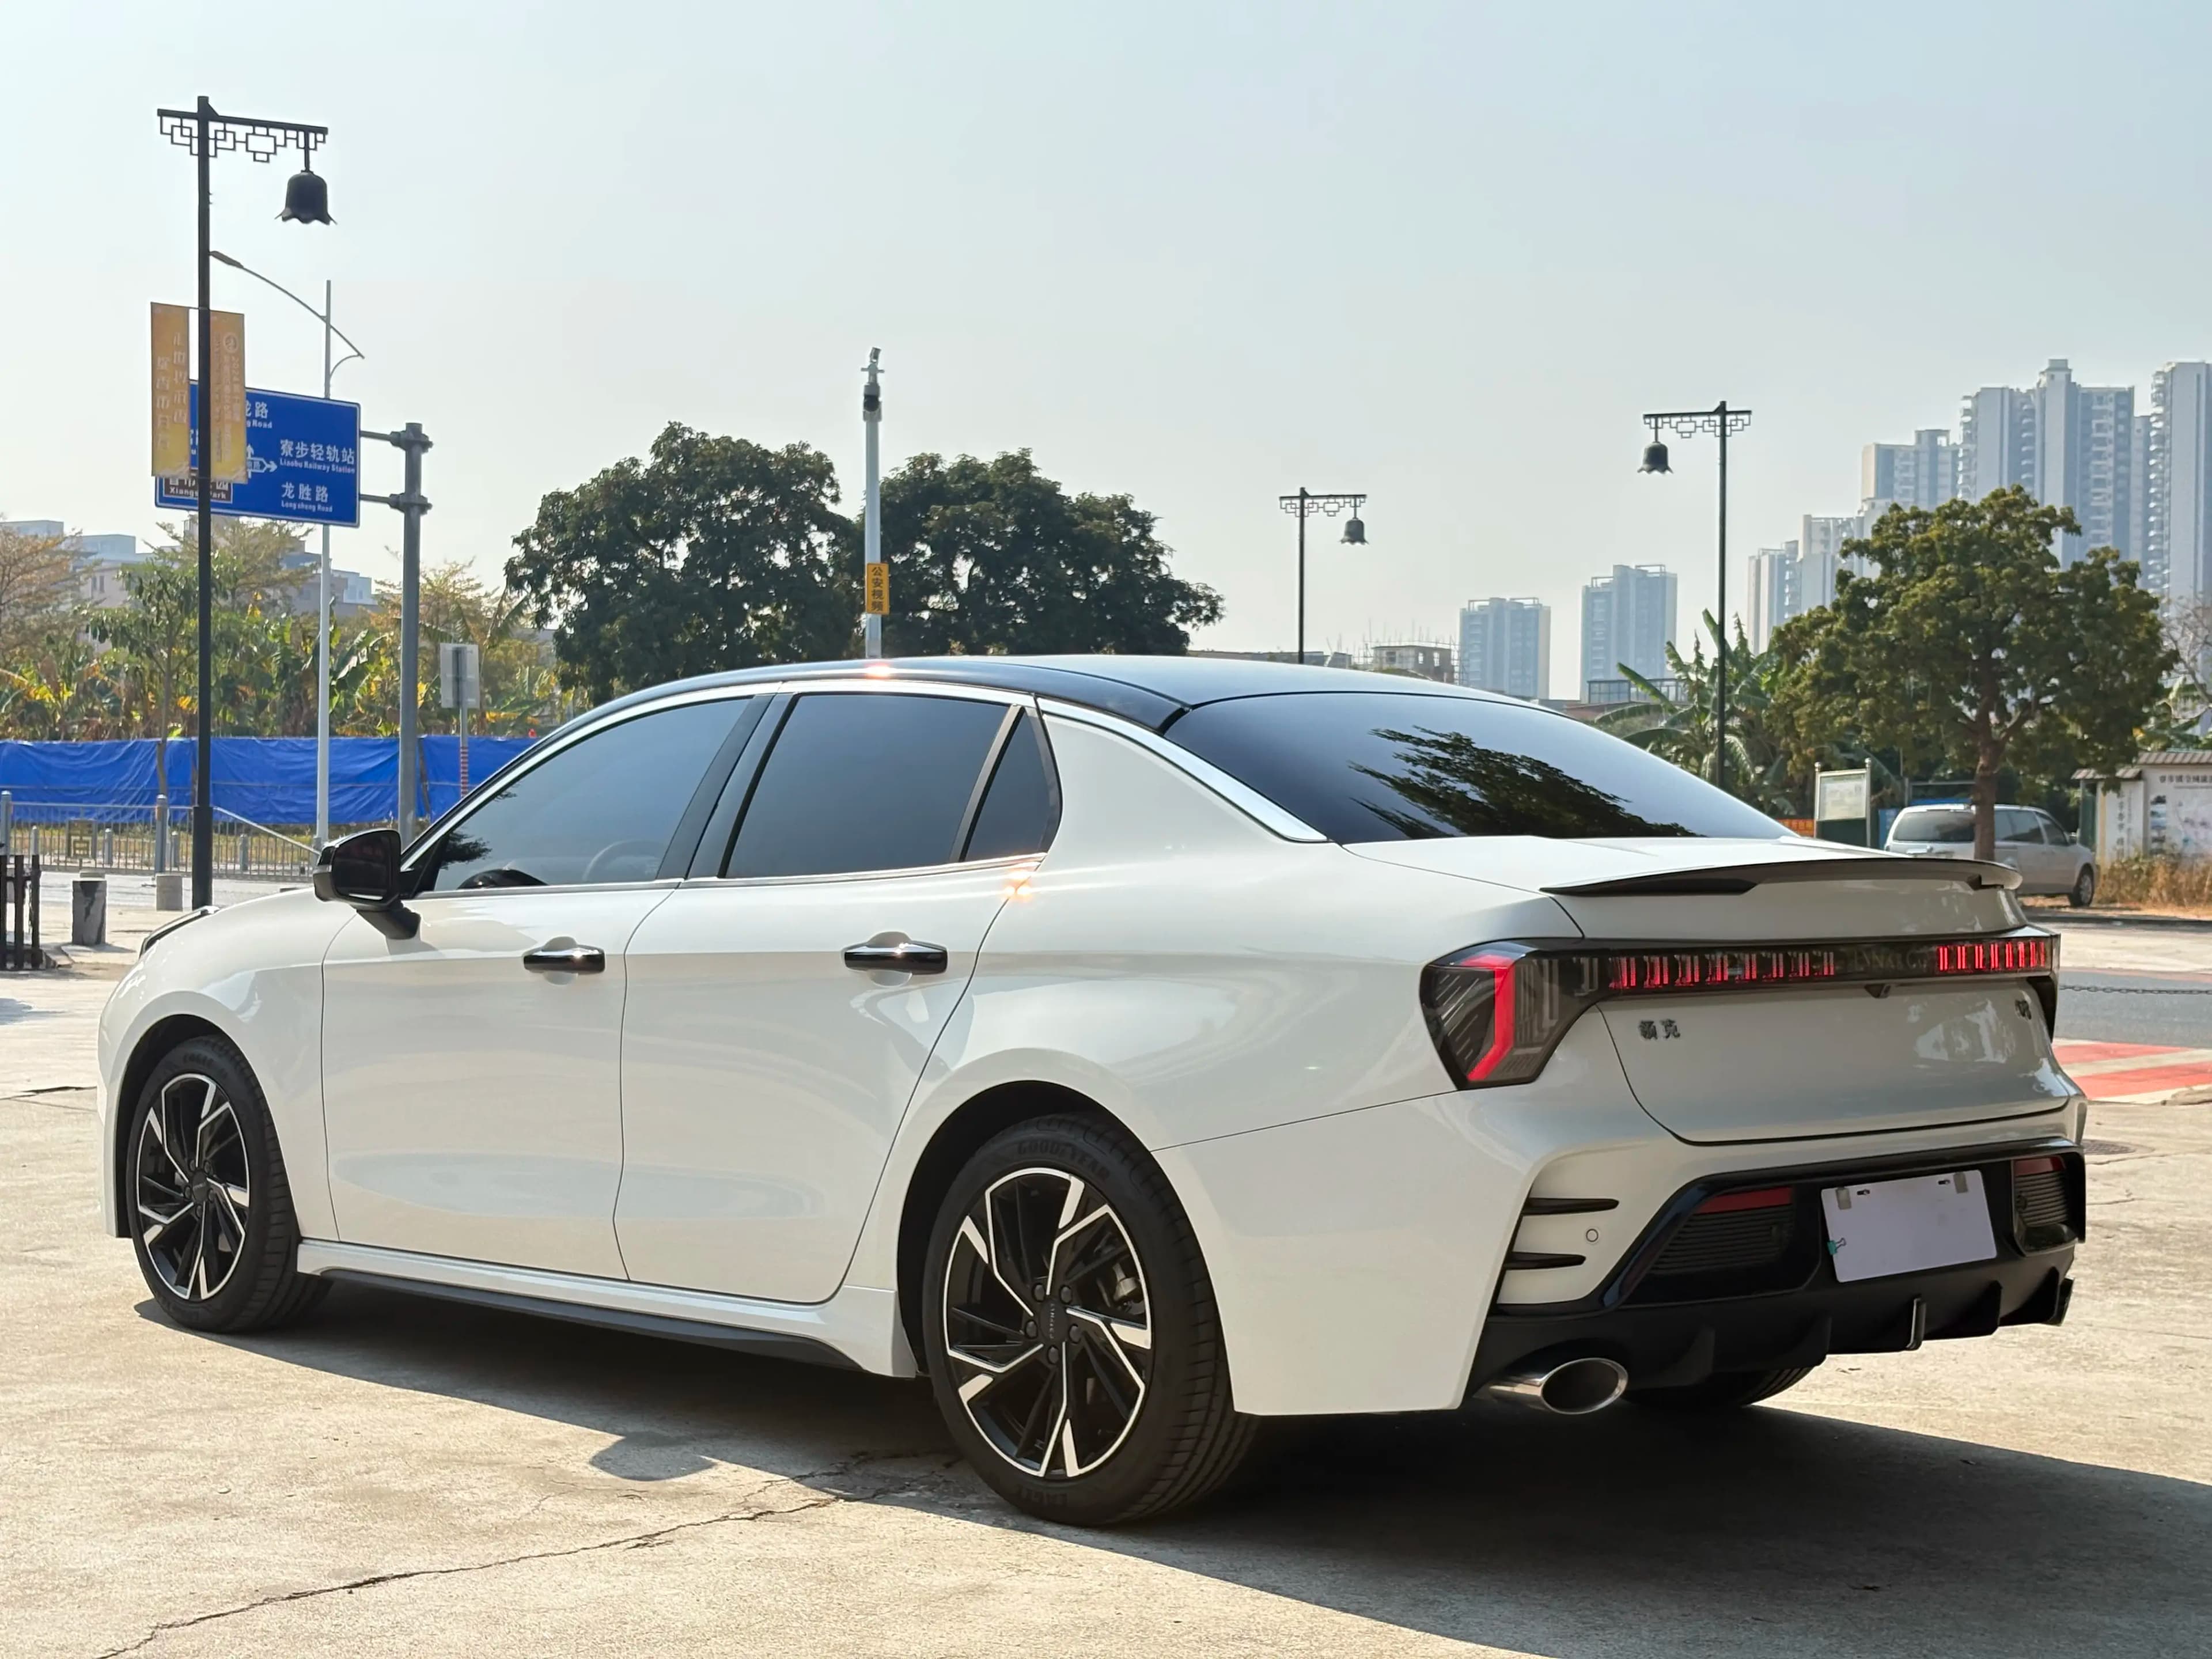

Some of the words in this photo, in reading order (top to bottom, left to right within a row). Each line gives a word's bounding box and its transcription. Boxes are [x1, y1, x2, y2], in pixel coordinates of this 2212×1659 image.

[252, 419, 272, 429] Road
[280, 440, 355, 465] 寮步轻轨站
[280, 458, 303, 468] Liaobu
[304, 461, 331, 472] Railway
[332, 464, 355, 474] Station
[170, 486, 199, 498] Xiangs
[210, 491, 226, 499] ark
[281, 482, 328, 503] 龙胜路
[317, 504, 333, 512] Road
[1638, 1018, 1681, 1040] 领克
